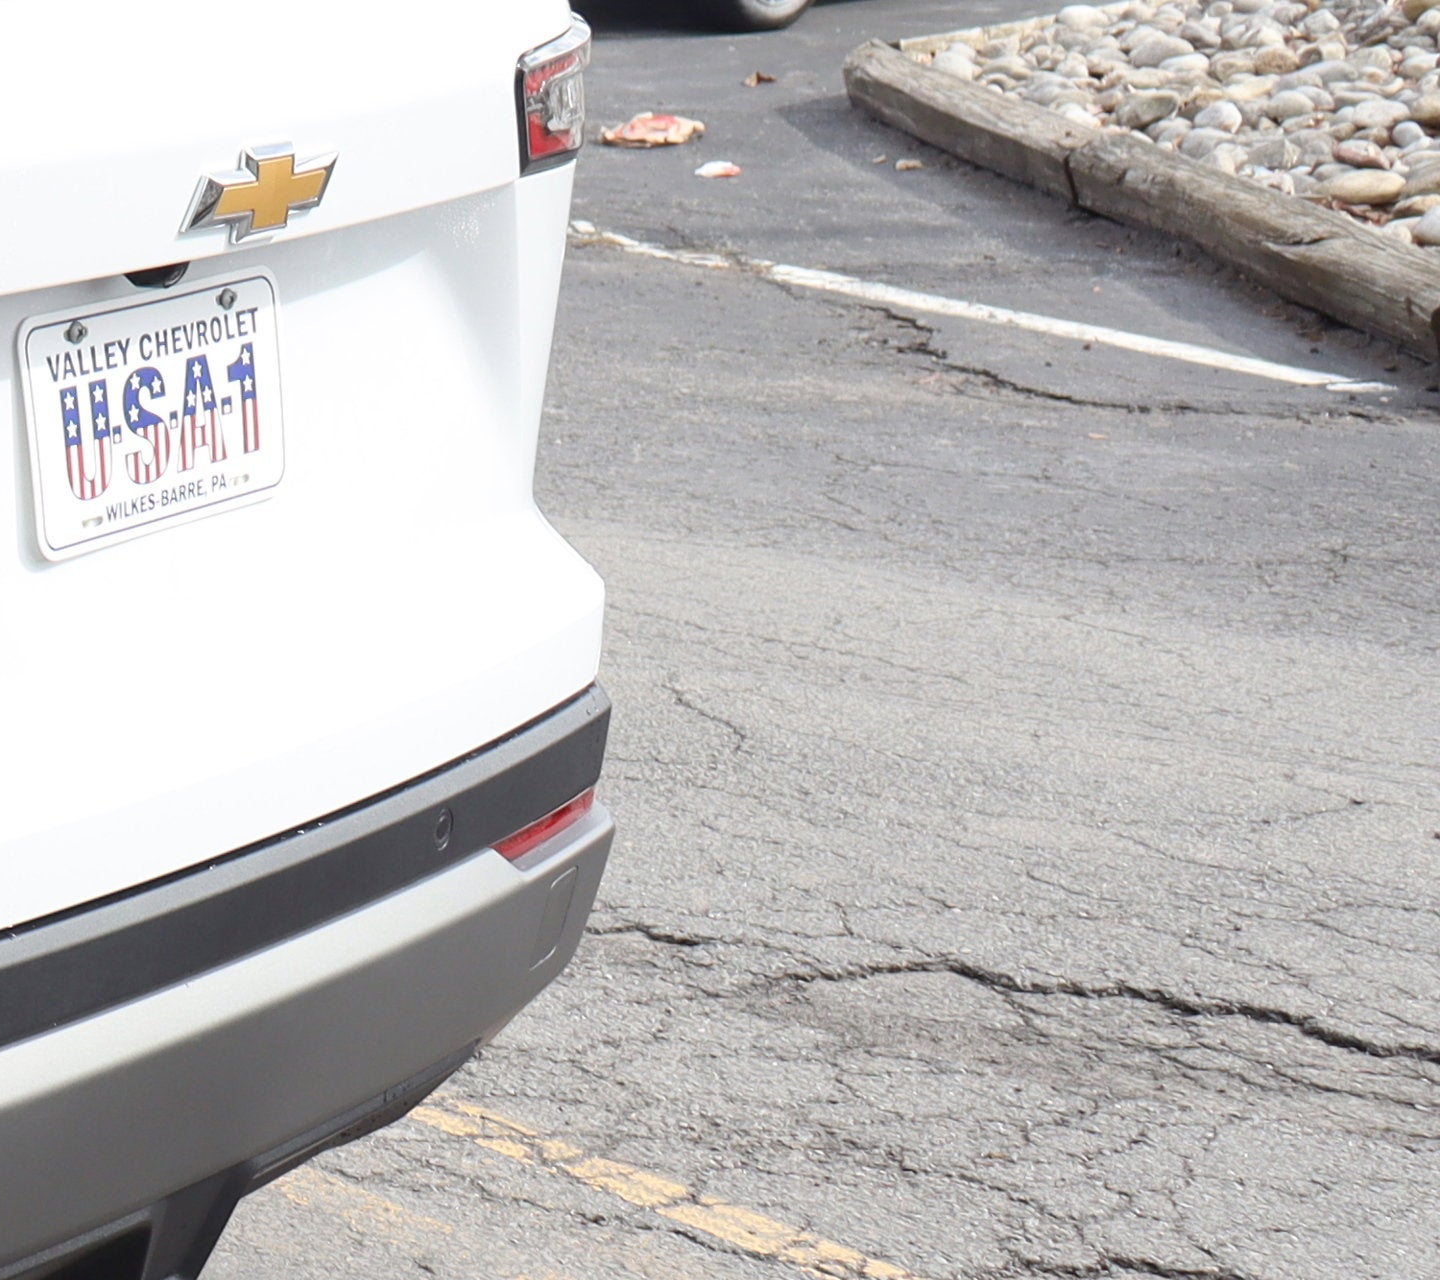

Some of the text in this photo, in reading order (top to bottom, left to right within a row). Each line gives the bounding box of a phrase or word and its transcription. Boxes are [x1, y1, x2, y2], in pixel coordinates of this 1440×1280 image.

[46, 308, 259, 382] VALLEY CHEVROLET
[107, 474, 228, 522] WILKES-BARRE, PA
